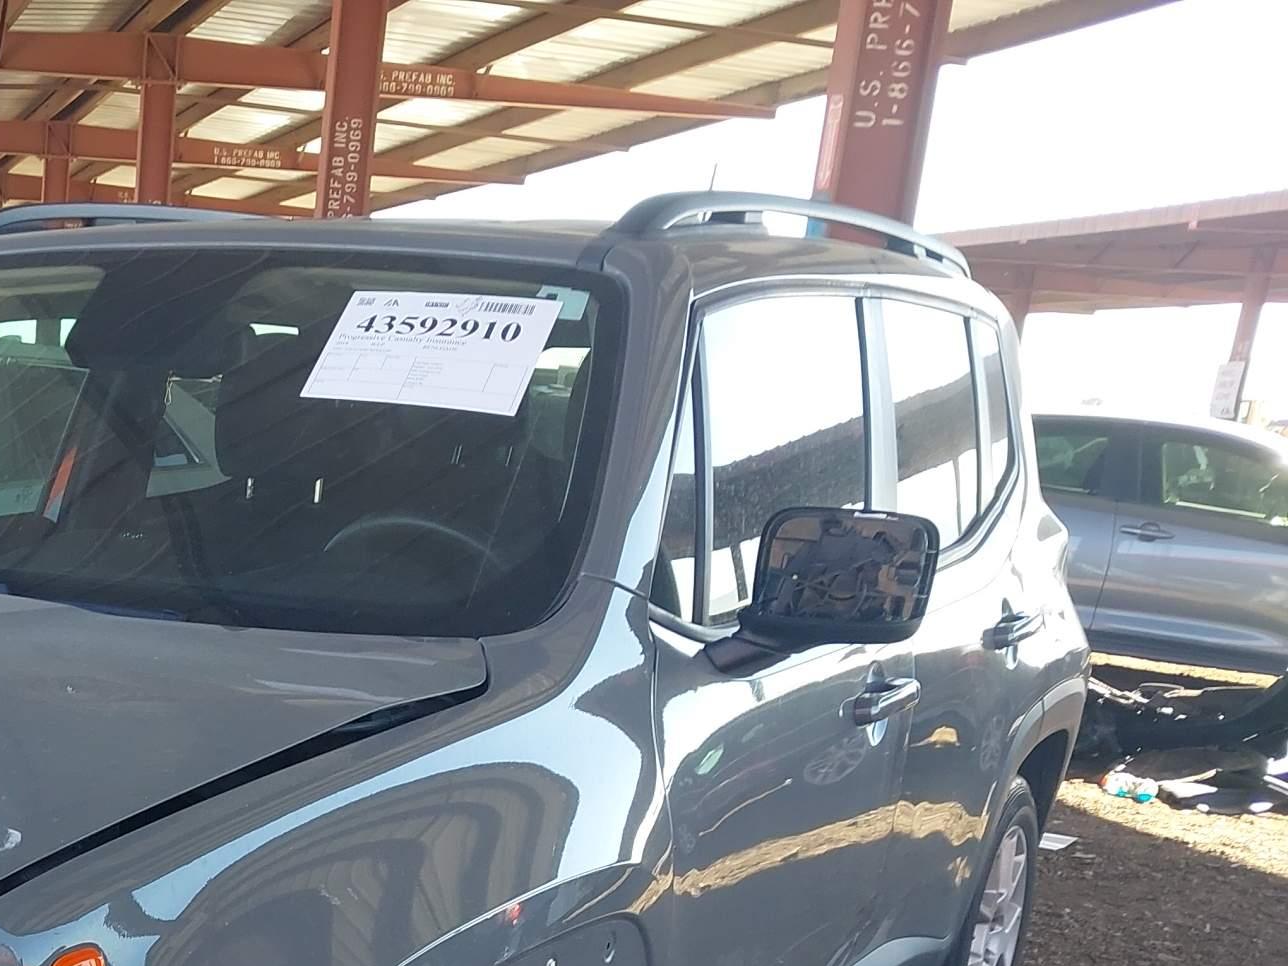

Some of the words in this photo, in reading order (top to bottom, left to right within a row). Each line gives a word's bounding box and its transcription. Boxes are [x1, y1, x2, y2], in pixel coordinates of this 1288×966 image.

[391, 70, 432, 83] PREFAB
[854, 71, 883, 128] U.S.
[334, 116, 349, 148] INC.
[356, 314, 522, 343] 43592910
